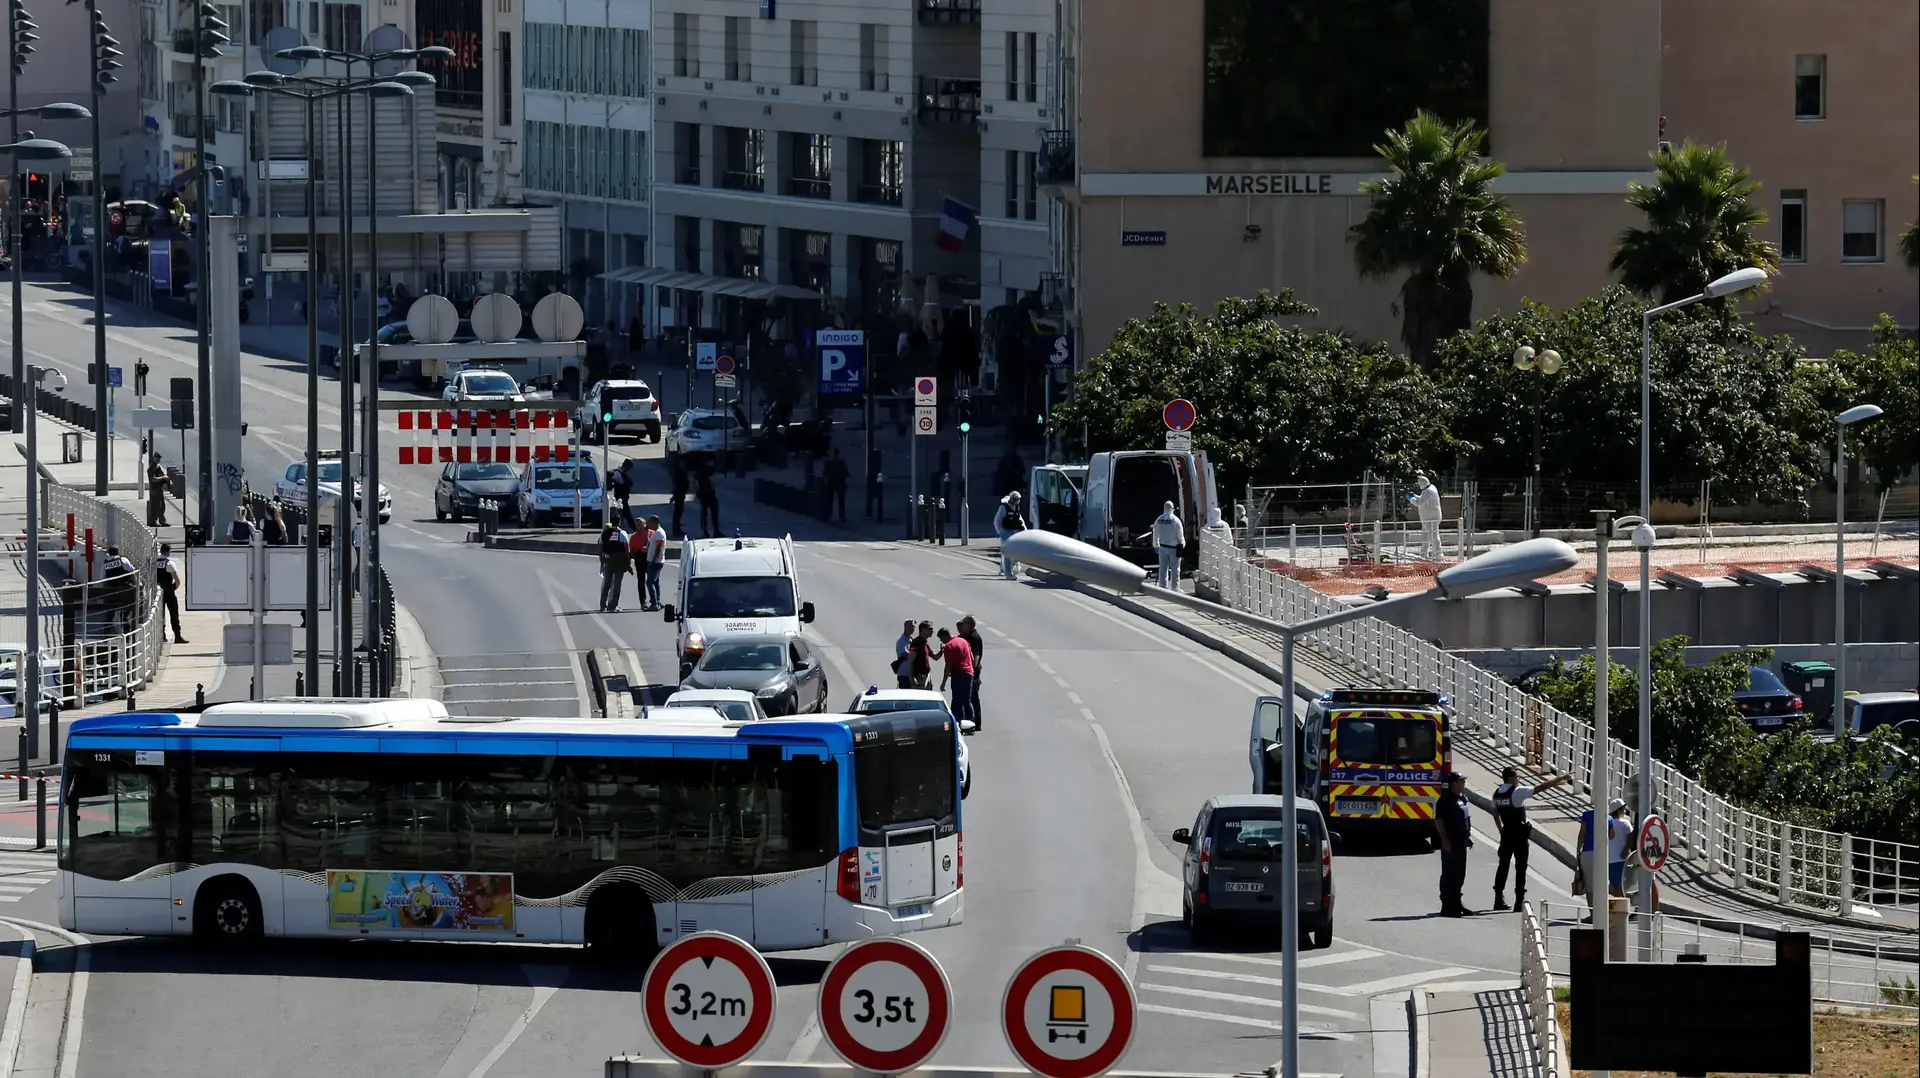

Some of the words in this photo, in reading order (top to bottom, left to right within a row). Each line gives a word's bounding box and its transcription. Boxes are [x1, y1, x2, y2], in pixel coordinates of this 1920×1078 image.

[1206, 175, 1332, 193] MARSEILLE
[1124, 234, 1164, 242] JCDecaux
[822, 334, 859, 342] INDIGO
[822, 350, 846, 381] P
[105, 560, 121, 569] POLICE
[865, 731, 878, 740] 1331
[94, 753, 111, 762] 1331
[1388, 772, 1428, 780] POLICE
[385, 891, 412, 908] Speed
[431, 892, 460, 907] Water
[671, 983, 746, 1020] 3,2m
[853, 989, 916, 1027] 3,5t
